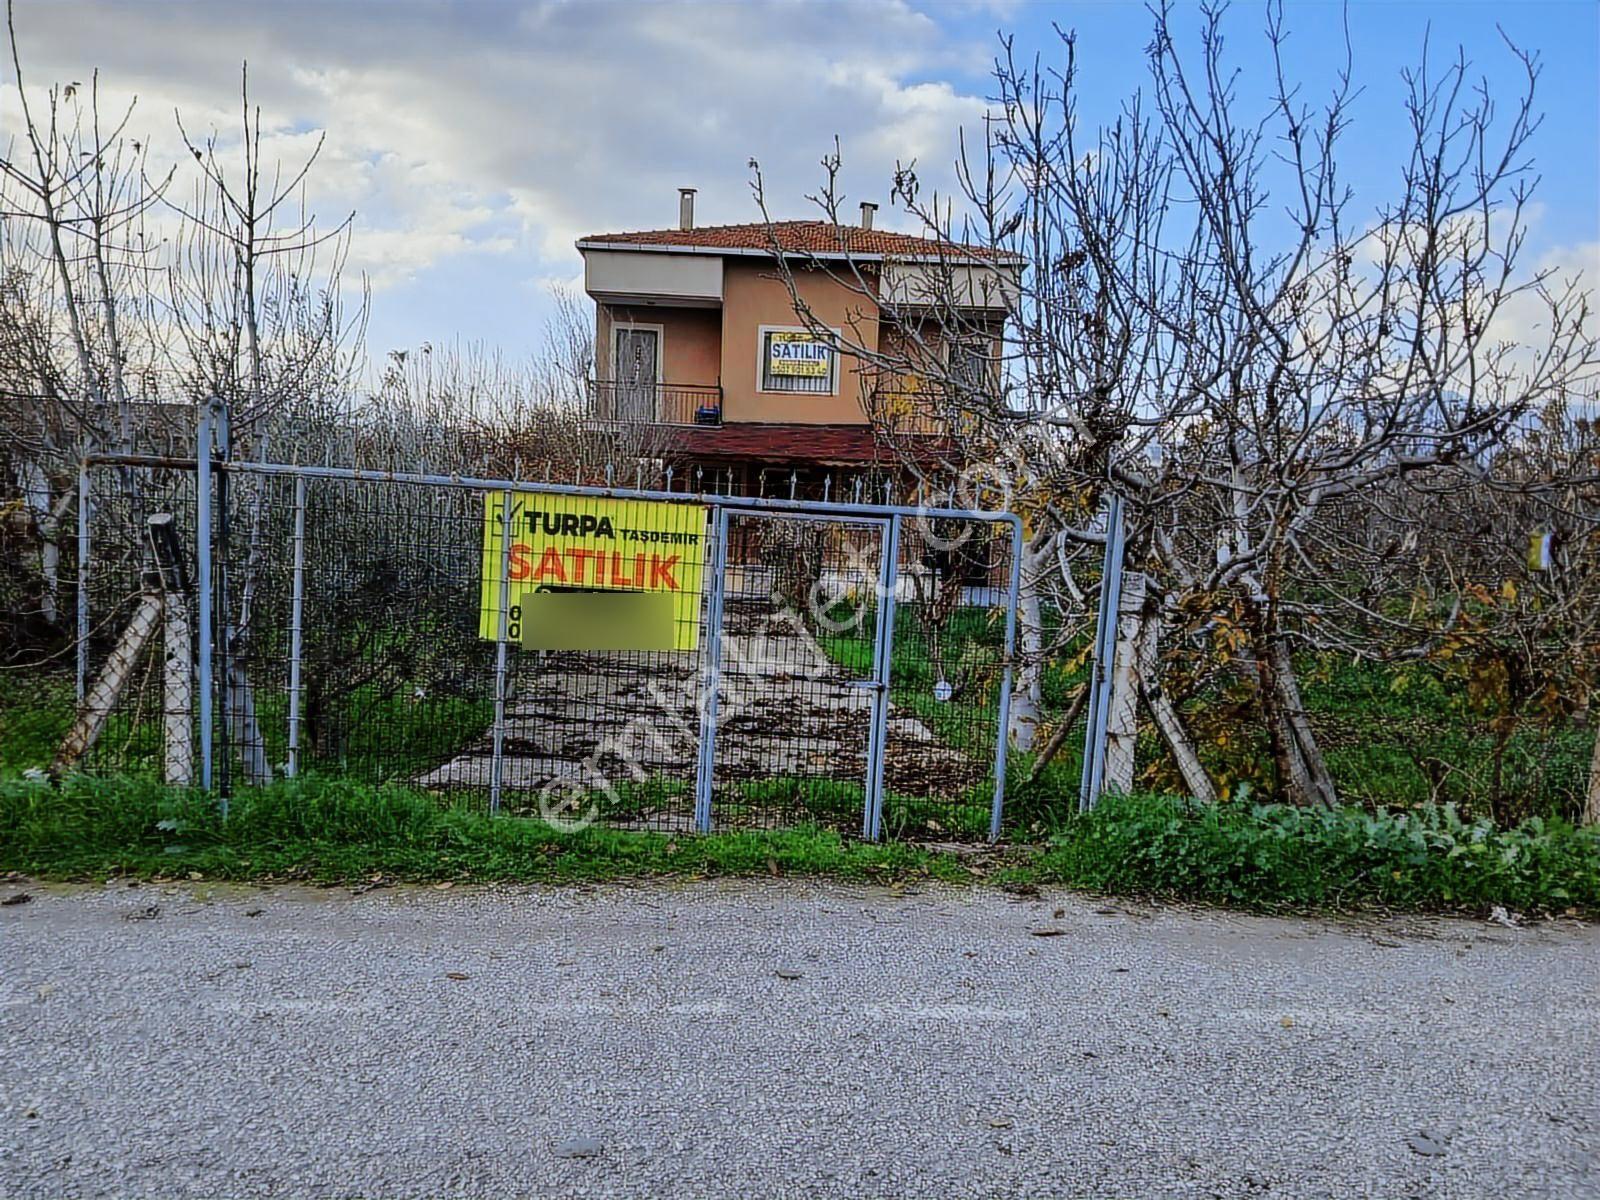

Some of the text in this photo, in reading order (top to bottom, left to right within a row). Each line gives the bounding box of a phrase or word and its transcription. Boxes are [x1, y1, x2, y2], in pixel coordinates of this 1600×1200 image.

[772, 343, 827, 359] SATILIK
[524, 511, 616, 539] TURPA
[508, 544, 682, 589] SATILIK
